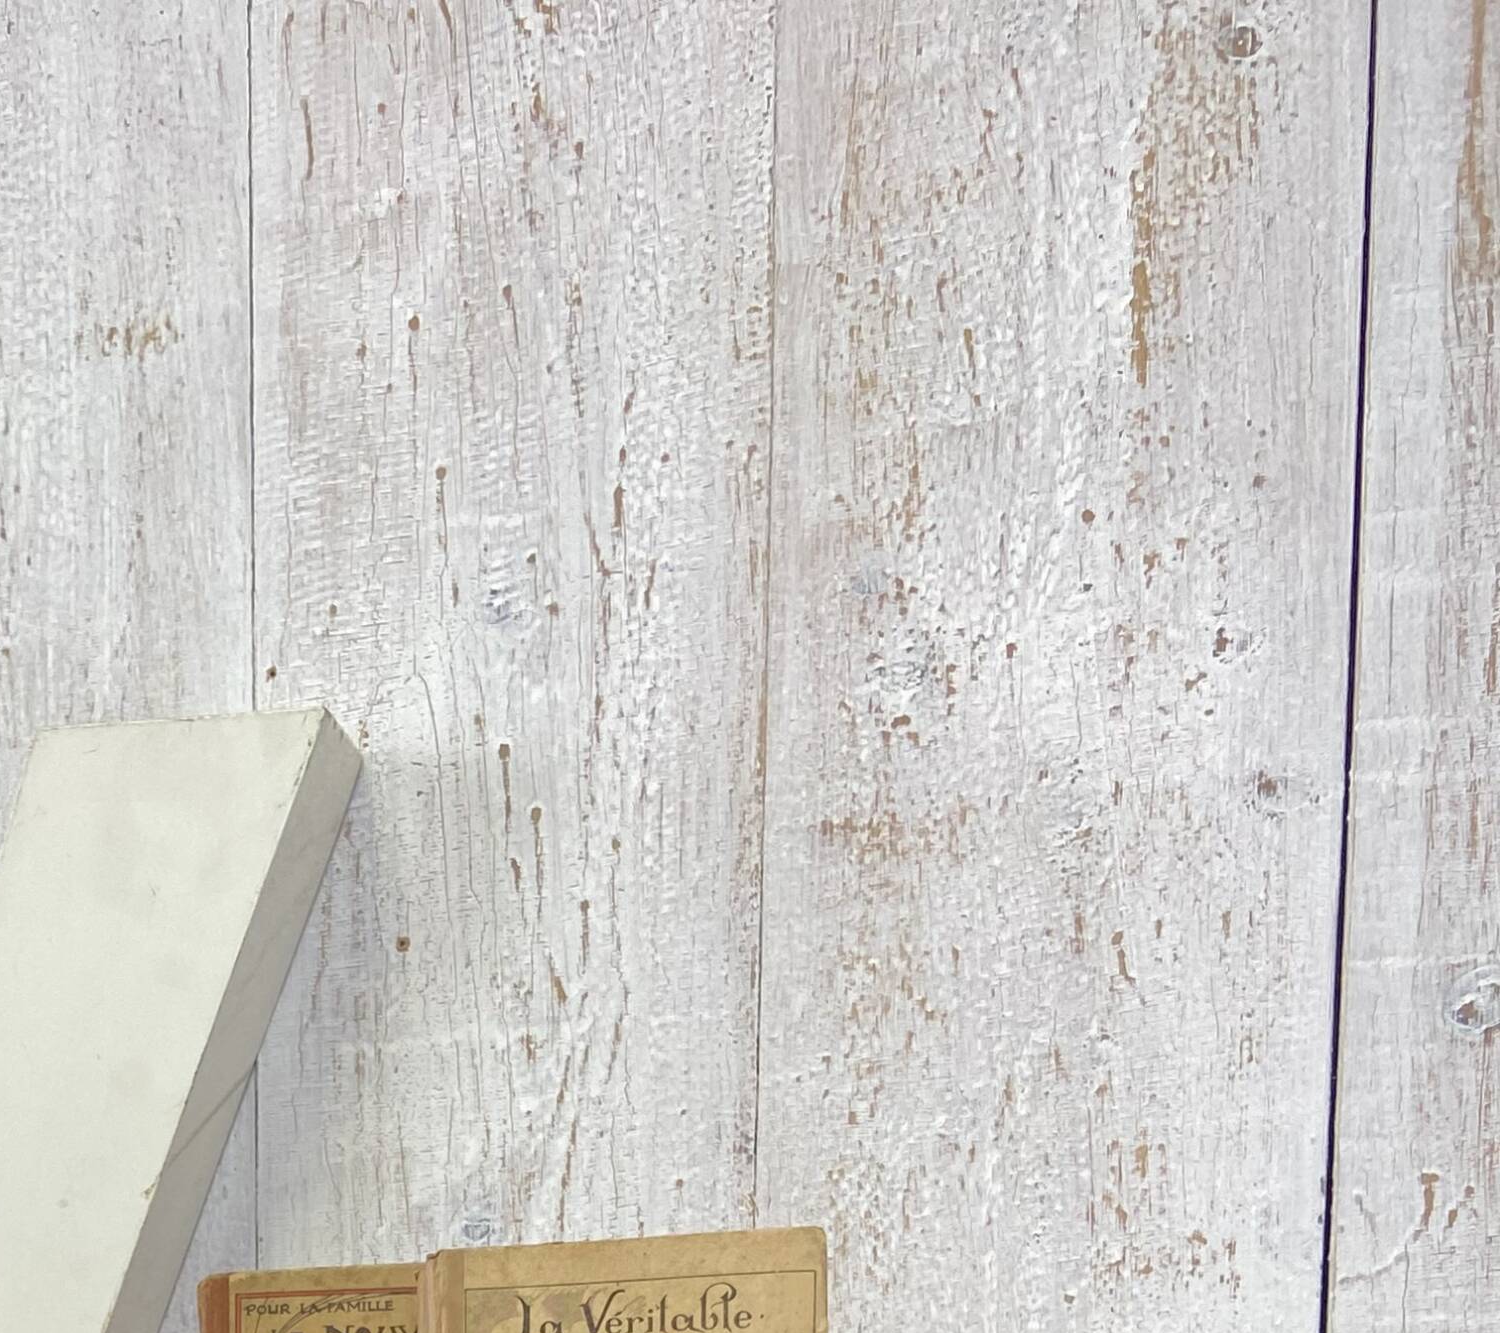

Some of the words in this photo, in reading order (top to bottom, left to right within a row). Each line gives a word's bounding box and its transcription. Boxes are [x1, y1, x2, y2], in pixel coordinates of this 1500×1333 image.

[245, 1303, 291, 1316] POUR
[300, 1302, 321, 1315] LA
[327, 1300, 394, 1313] FAMILLE
